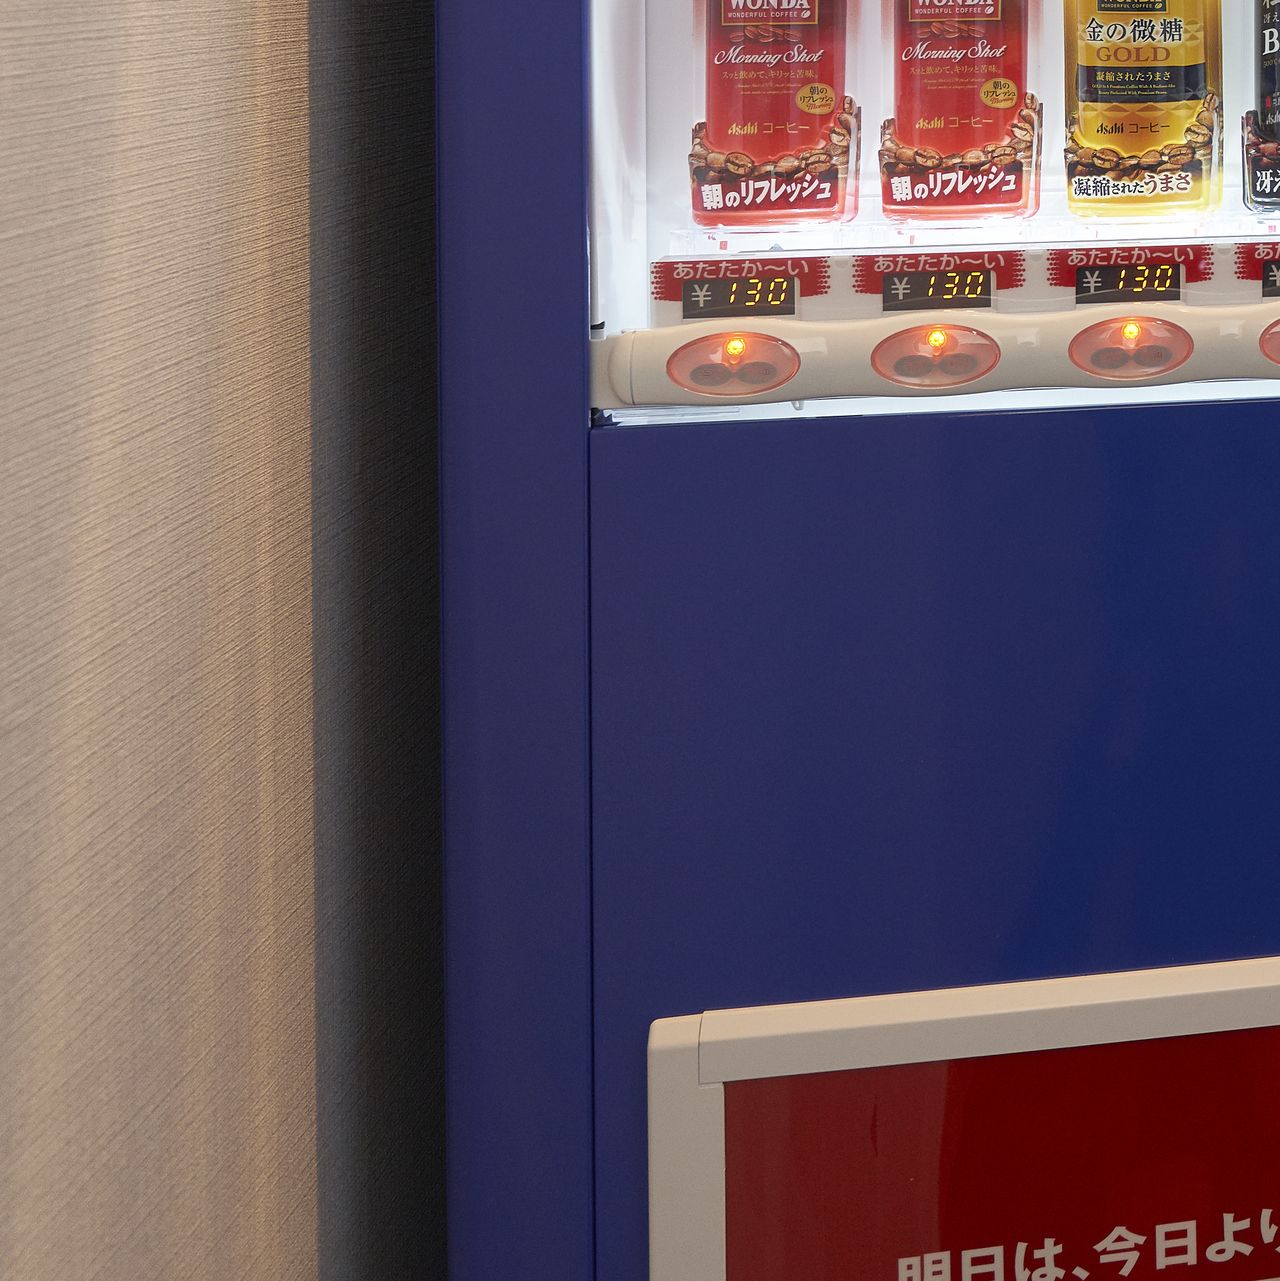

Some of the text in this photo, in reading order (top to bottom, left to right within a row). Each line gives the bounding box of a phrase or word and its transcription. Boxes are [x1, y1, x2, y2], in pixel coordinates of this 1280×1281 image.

[1085, 17, 1184, 44] 金の微糖
[714, 44, 823, 67] Morning Shot
[1096, 45, 1171, 62] GOLD
[1096, 121, 1171, 135] Asahi コーヒー
[701, 173, 833, 211] 朝のリフレッシュ
[890, 165, 1017, 202] 朝のリフレッシュ
[1073, 171, 1192, 197] 凝縮されたうまさ
